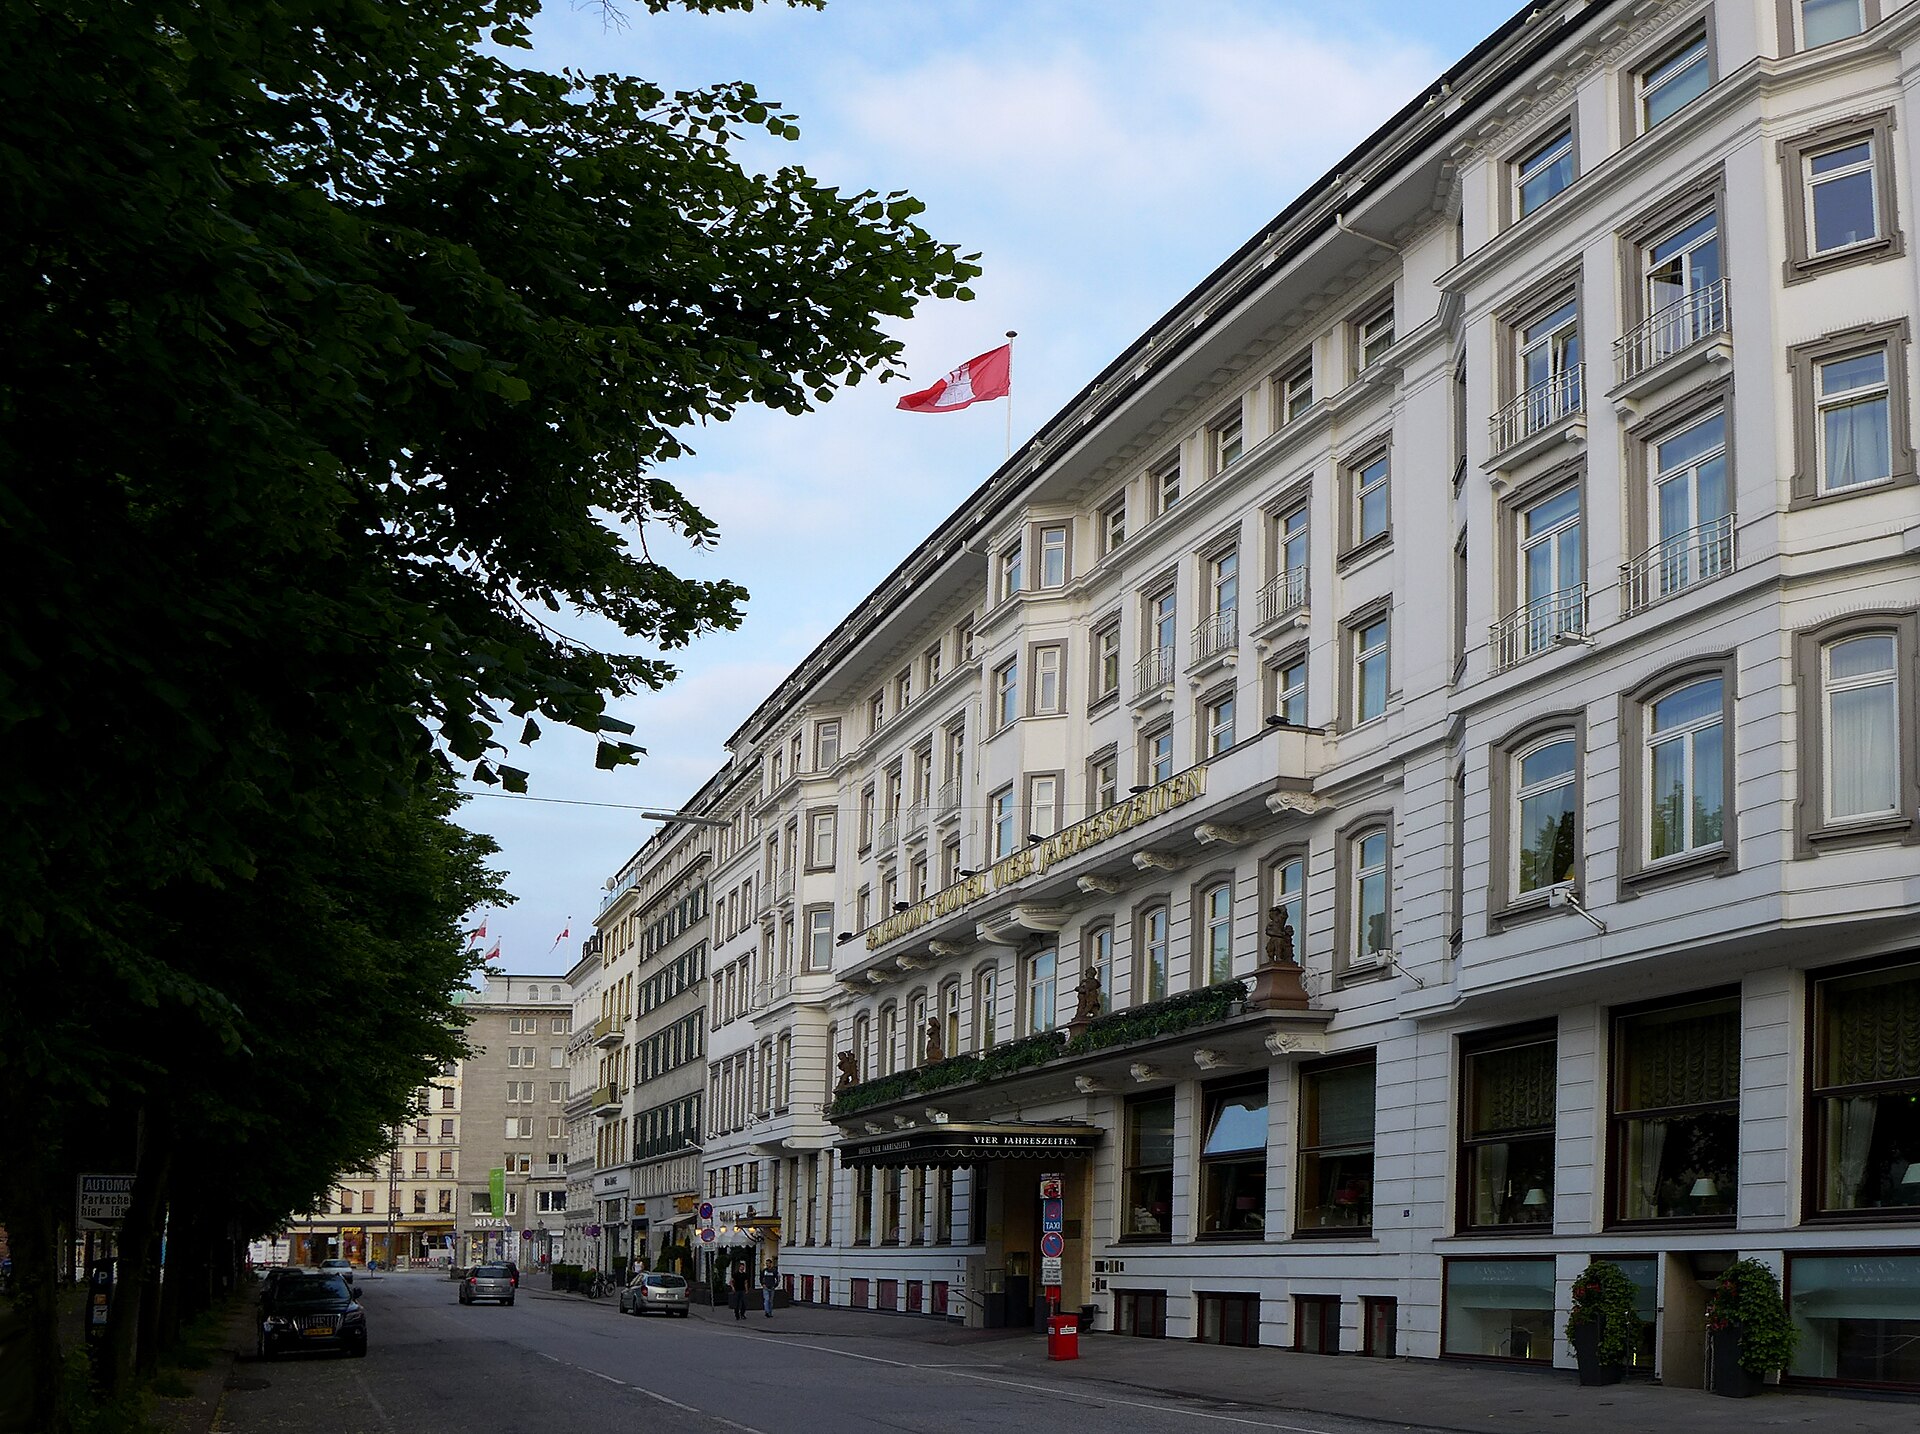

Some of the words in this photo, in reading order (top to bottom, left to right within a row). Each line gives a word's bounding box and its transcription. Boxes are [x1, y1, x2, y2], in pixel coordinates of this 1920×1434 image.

[935, 875, 987, 917] HOTEL
[992, 848, 1036, 891] VIER
[1037, 766, 1208, 875] JAHRESZEITEN
[973, 1136, 999, 1145] VIER
[1003, 1137, 1078, 1146] JAHRESZEITEN
[81, 1193, 132, 1205] Parksche
[81, 1205, 102, 1217] hier
[111, 1205, 128, 1217] lös
[475, 1218, 510, 1227] NIVEA
[1045, 1221, 1061, 1230] TAXI
[98, 1271, 109, 1284] P
